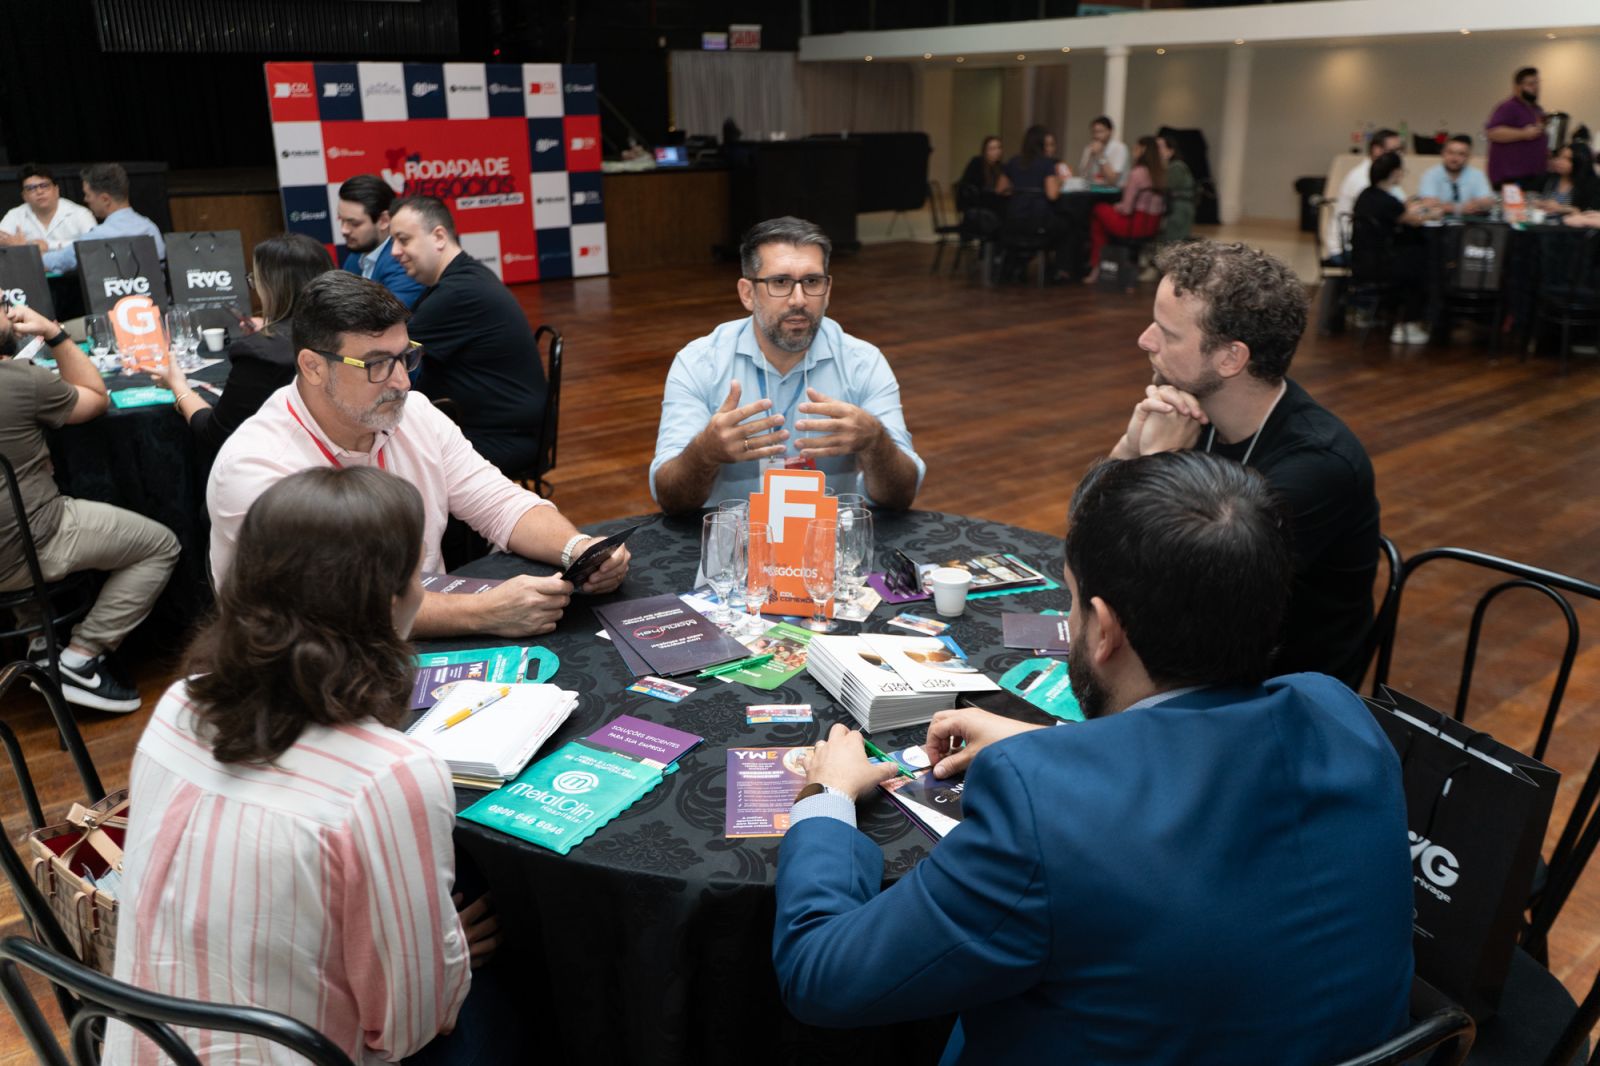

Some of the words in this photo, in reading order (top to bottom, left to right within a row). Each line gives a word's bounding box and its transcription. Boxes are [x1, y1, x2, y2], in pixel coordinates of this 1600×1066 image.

[405, 160, 484, 179] RODADA
[484, 157, 510, 175] DE
[104, 276, 150, 297] RVG
[187, 270, 232, 288] RVG
[116, 298, 157, 335] G
[766, 475, 819, 543] F
[607, 732, 624, 741] PARA
[638, 741, 666, 753] EMPRESA
[611, 725, 646, 739] SOLUÇÕES
[735, 751, 778, 760] YWE
[488, 804, 515, 817] 0800
[515, 812, 537, 825] 646
